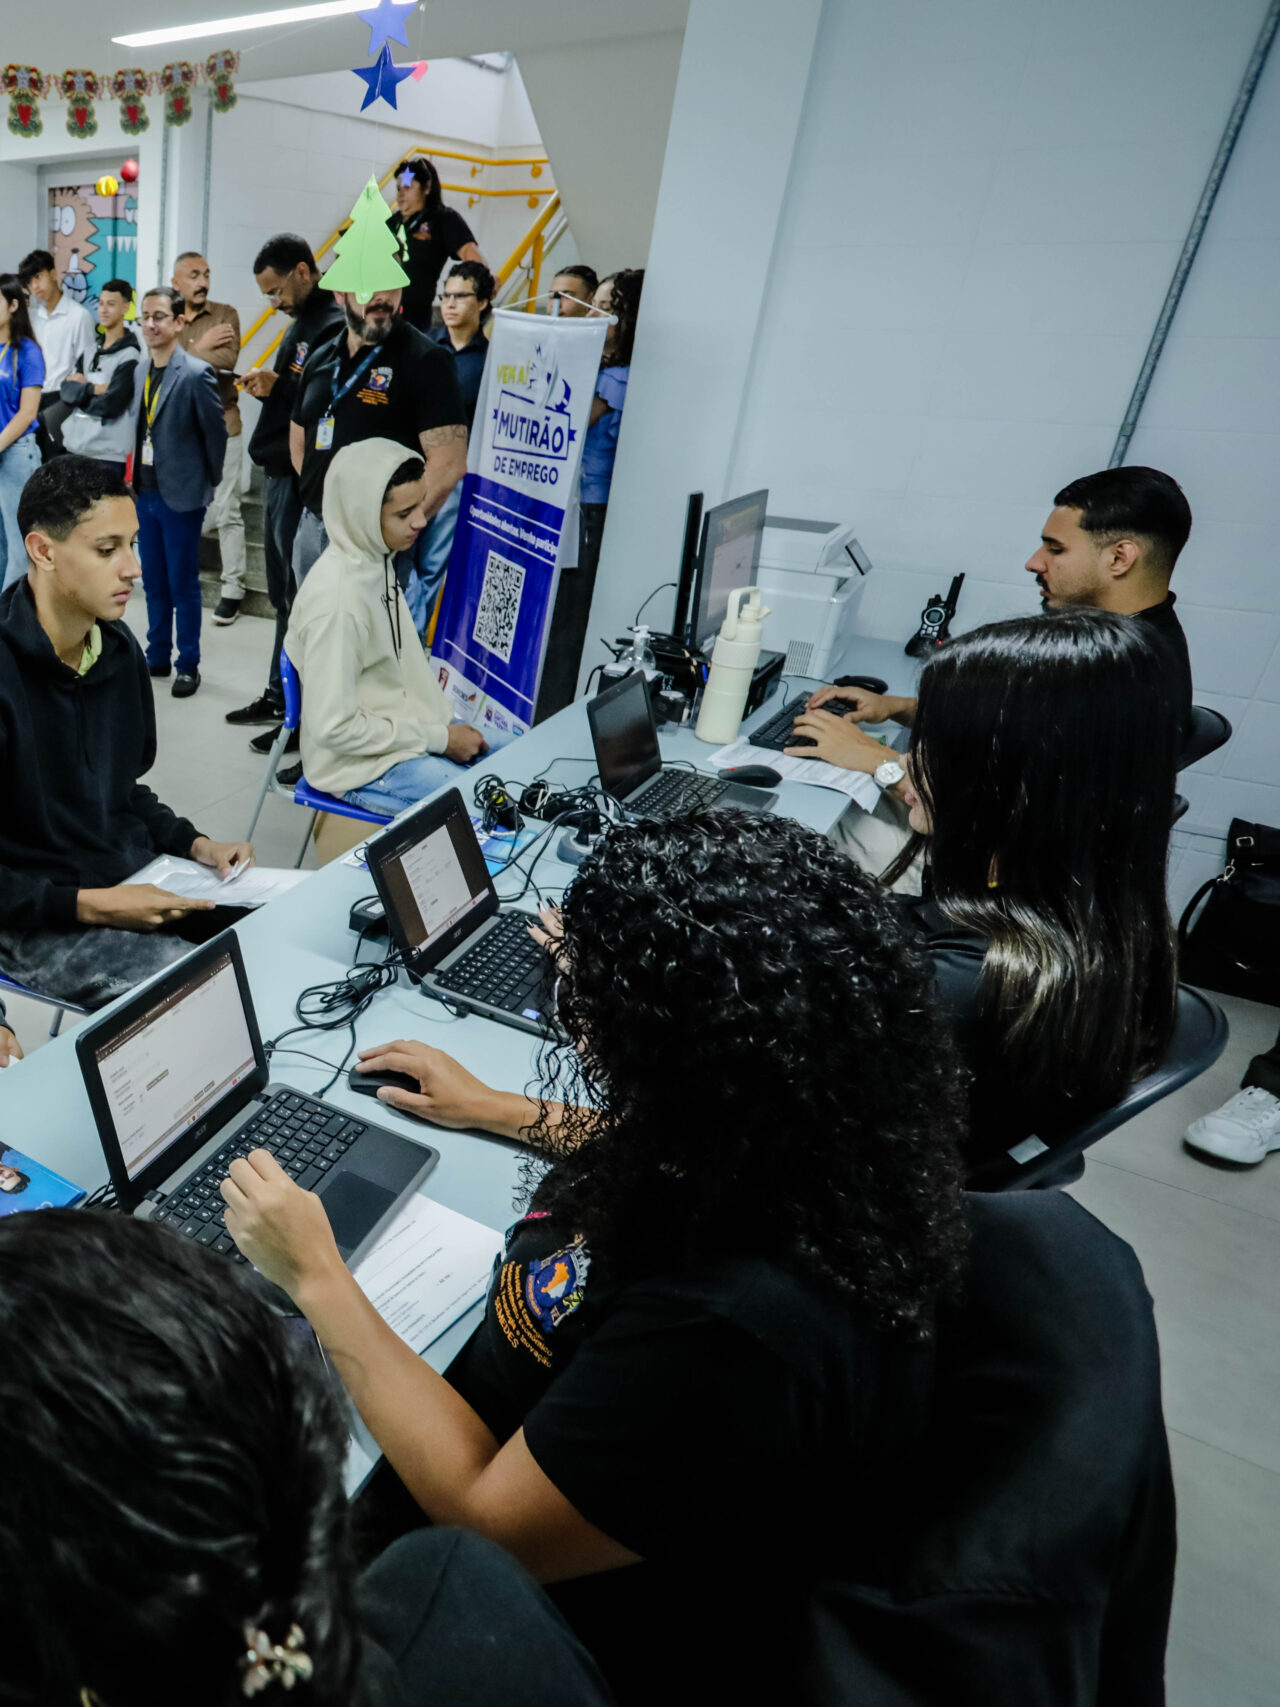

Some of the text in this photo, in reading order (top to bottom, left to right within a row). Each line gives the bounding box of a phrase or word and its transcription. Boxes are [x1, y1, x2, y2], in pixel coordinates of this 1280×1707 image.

[498, 411, 564, 454] MUTIRÃO
[494, 455, 558, 485] DE EMPREGO
[495, 1296, 520, 1348] SEMEDES
